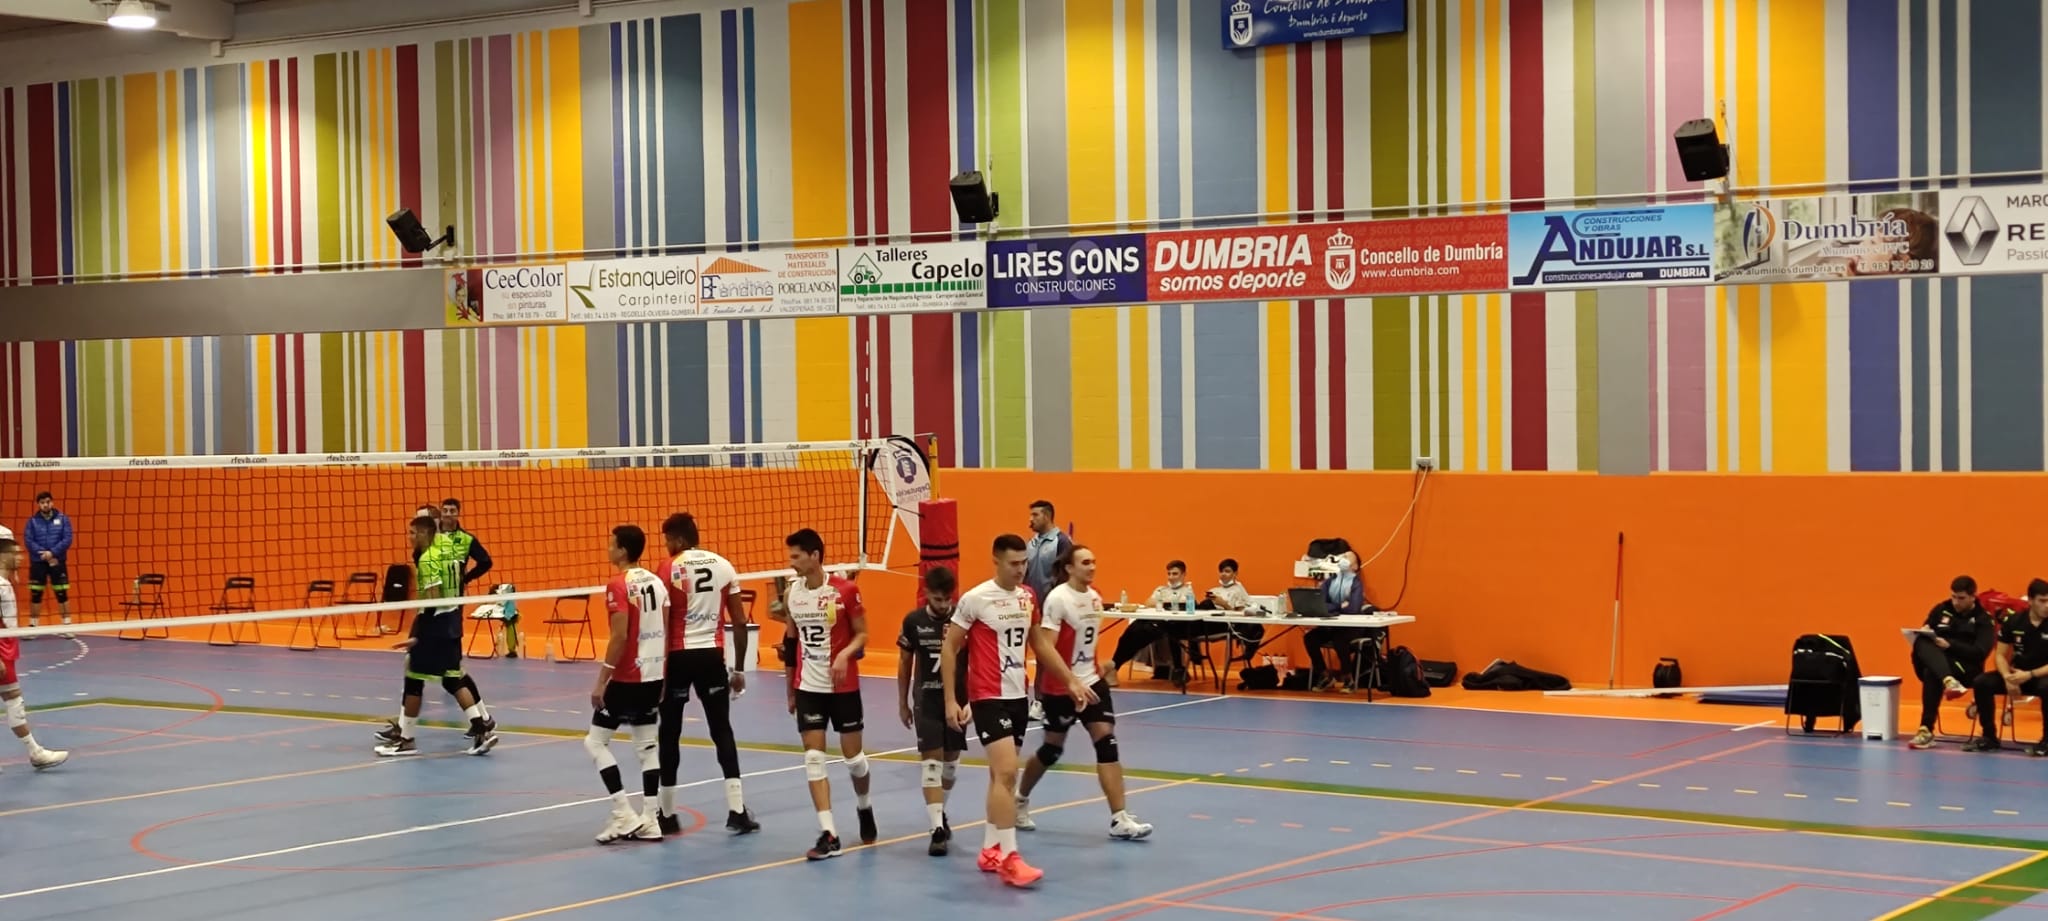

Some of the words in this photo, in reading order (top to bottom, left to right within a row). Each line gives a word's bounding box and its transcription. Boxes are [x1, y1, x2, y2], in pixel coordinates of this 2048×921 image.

[1584, 214, 1663, 226] CONSTRUCCIONES
[1592, 224, 1621, 232] OBRAS
[1783, 212, 1909, 241] Dumbría
[785, 251, 829, 260] TRANSPORTES
[876, 248, 927, 262] Talleres
[1154, 234, 1313, 272] DUMBRIA
[1360, 246, 1419, 265] Concello
[1424, 245, 1441, 262] de
[1445, 242, 1503, 261] Dumbría
[1513, 215, 1682, 285] ANDUJAR
[788, 261, 826, 269] MATERIALES
[993, 250, 1063, 278] LIRES
[1070, 246, 1139, 275] CONS
[485, 267, 564, 289] CeeColor
[599, 266, 696, 290] Estanqueiro
[911, 258, 984, 283] Capelo
[1361, 265, 1460, 278] www.dumbria.com
[1544, 271, 1644, 283] construccionesandujar.com
[779, 281, 836, 294] PORCELANOSA
[1015, 278, 1116, 294] CONSTRUCCIONES
[1160, 274, 1224, 292] somos
[1228, 268, 1306, 293] deporte
[511, 290, 552, 299] especialista
[518, 301, 546, 310] pinturas
[18, 459, 61, 468] rfevb.com
[129, 458, 168, 466] rfevb.com
[231, 456, 267, 464] rfevb.com
[326, 454, 360, 462] rfevb.com
[416, 452, 448, 461] rfevb.com
[695, 567, 713, 593] 2
[641, 584, 656, 613] 11
[801, 626, 825, 642] 12
[1004, 627, 1024, 647] 13
[1084, 626, 1095, 645] 9
[929, 652, 941, 673] 7
